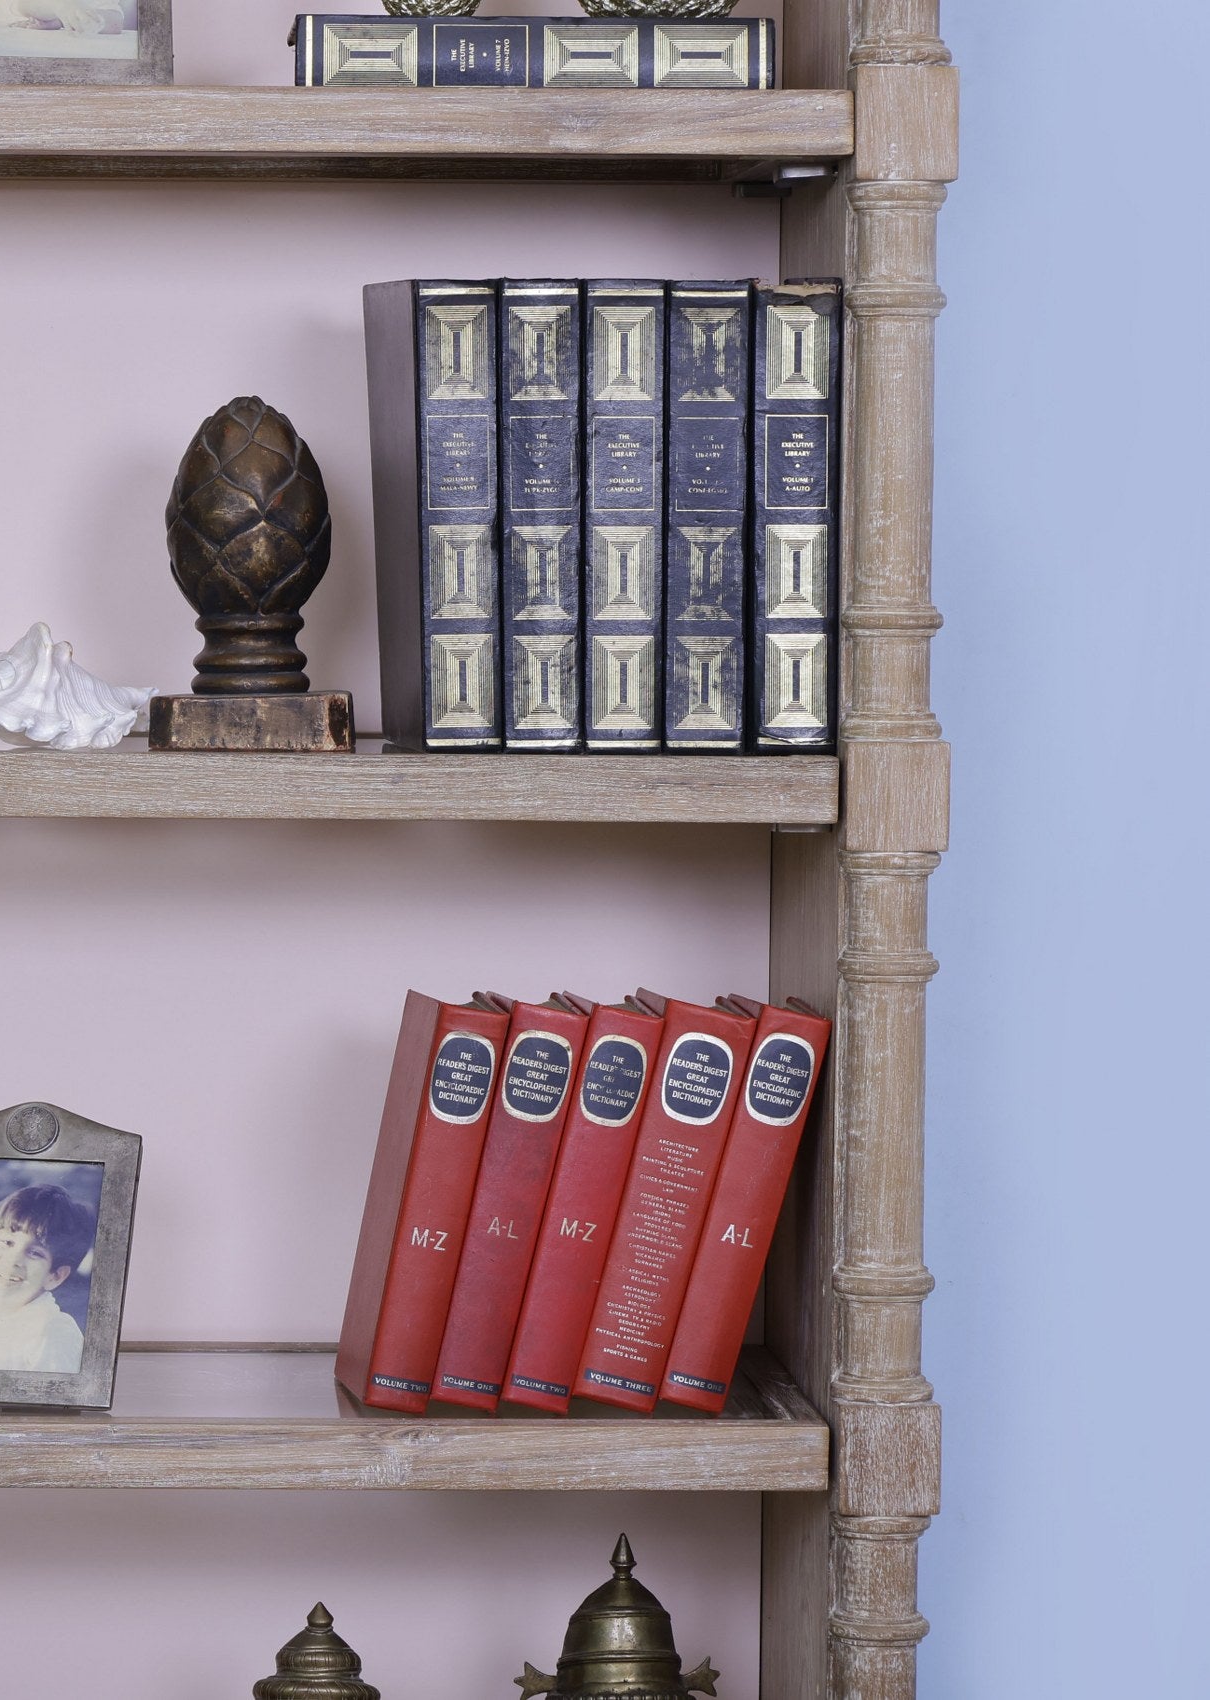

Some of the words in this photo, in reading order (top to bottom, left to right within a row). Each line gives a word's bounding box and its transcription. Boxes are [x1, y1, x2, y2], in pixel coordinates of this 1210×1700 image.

[460, 1051, 472, 1061] THE
[536, 1050, 550, 1060] THE
[612, 1055, 625, 1065] THE
[696, 1052, 710, 1063] THE
[779, 1053, 793, 1064] THE
[467, 1064, 490, 1075] DIGEST
[526, 1070, 549, 1081] GREAT
[543, 1063, 568, 1075] DIGEST
[703, 1065, 728, 1078] DIGEST
[786, 1066, 809, 1079] DIGEST
[451, 1071, 473, 1082] GREAT
[686, 1072, 709, 1084] GREAT
[770, 1073, 791, 1085] GREAT
[435, 1079, 485, 1096] ENCYCLOPAEDIC
[508, 1076, 562, 1095] ENCYCLOPAEDIC
[668, 1078, 722, 1098] ENCYCLOPAEDIC
[752, 1080, 803, 1099] ENCYCLOPAEDIC
[438, 1091, 478, 1105] DICTIONARY
[512, 1088, 554, 1104] DICTIONARY
[590, 1093, 628, 1108] DICTIONARY
[671, 1090, 713, 1107] DICTIONARY
[755, 1091, 795, 1108] DICTIONARY
[658, 1138, 699, 1153] ARCHITECTURE
[660, 1146, 693, 1159] LITERATURE
[673, 1164, 705, 1177] SCULPTURE
[639, 1173, 658, 1183] CIVICS
[486, 1216, 519, 1240] A-L
[560, 1217, 597, 1242] M-Z
[410, 1226, 448, 1251] M-Z
[721, 1223, 753, 1249] A-L
[622, 1284, 661, 1298] ARCHAEOLOGY
[595, 1327, 622, 1339] PHYSICAL
[622, 1335, 665, 1349] ANTHROPOLOGY
[619, 1326, 645, 1336] MEDICINE
[603, 1347, 624, 1357] SPORTS
[629, 1354, 648, 1363] GAMES
[616, 1343, 638, 1353] FISHING
[374, 1376, 408, 1390] VOLUME
[409, 1384, 428, 1392] TWO
[443, 1375, 476, 1389] VOLUME
[476, 1382, 494, 1392] ONE
[513, 1377, 547, 1391] VOLUME
[548, 1385, 566, 1394] TWO
[590, 1372, 623, 1386] VOLUME
[625, 1381, 653, 1393] THREE
[672, 1374, 705, 1388] VOLUME
[706, 1383, 723, 1392] ONE
